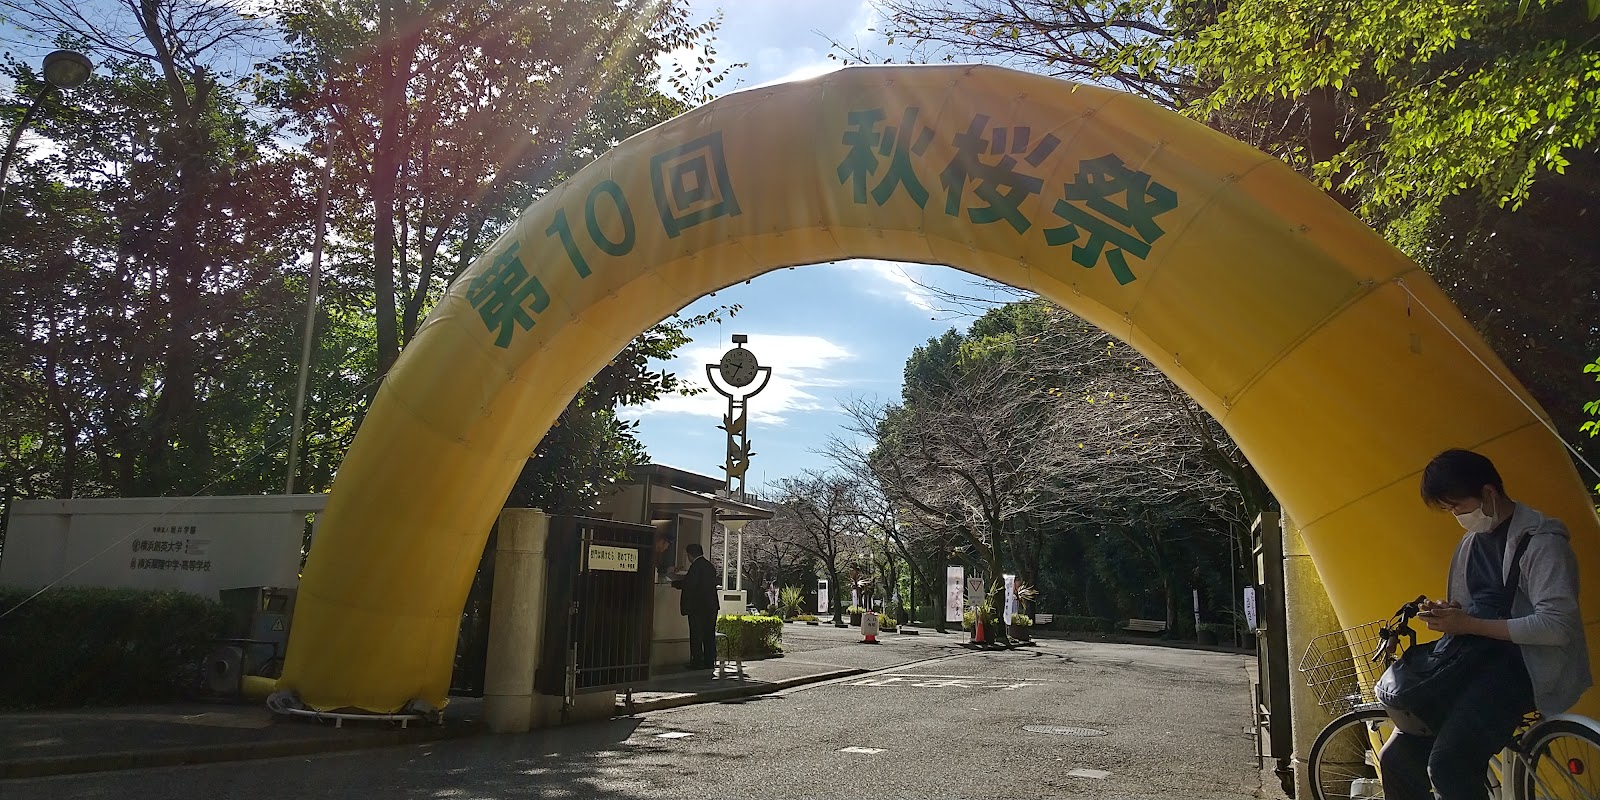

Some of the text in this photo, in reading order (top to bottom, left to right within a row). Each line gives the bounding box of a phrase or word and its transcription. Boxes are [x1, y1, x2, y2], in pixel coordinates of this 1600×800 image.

[465, 107, 1179, 349] 第10回 秋桜祭
